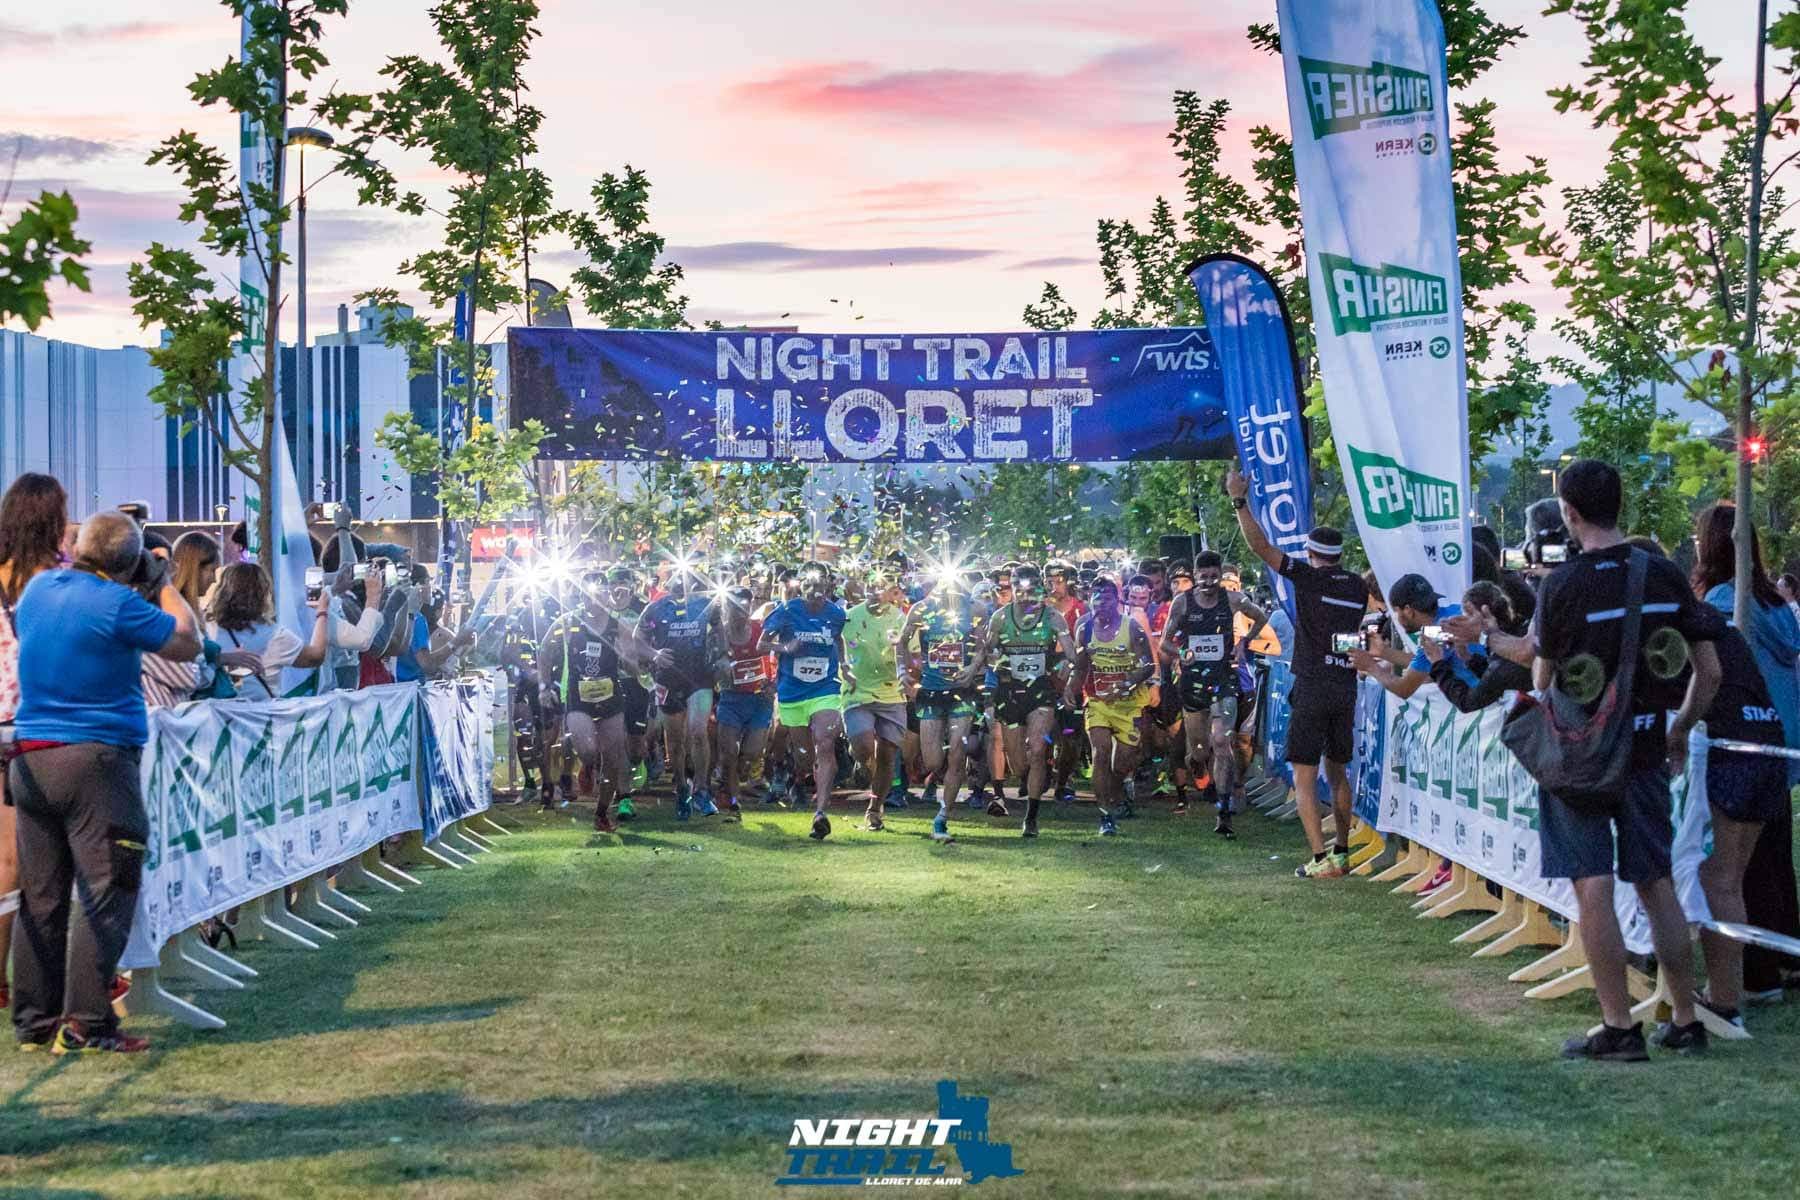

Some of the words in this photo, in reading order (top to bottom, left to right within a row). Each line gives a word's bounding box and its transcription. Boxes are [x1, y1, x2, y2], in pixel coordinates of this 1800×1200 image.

[716, 337, 902, 381] NIGHT
[913, 336, 1087, 381] TRAIL
[1146, 346, 1210, 371] wts
[715, 388, 1094, 460] LLORET
[800, 666, 822, 676] 372
